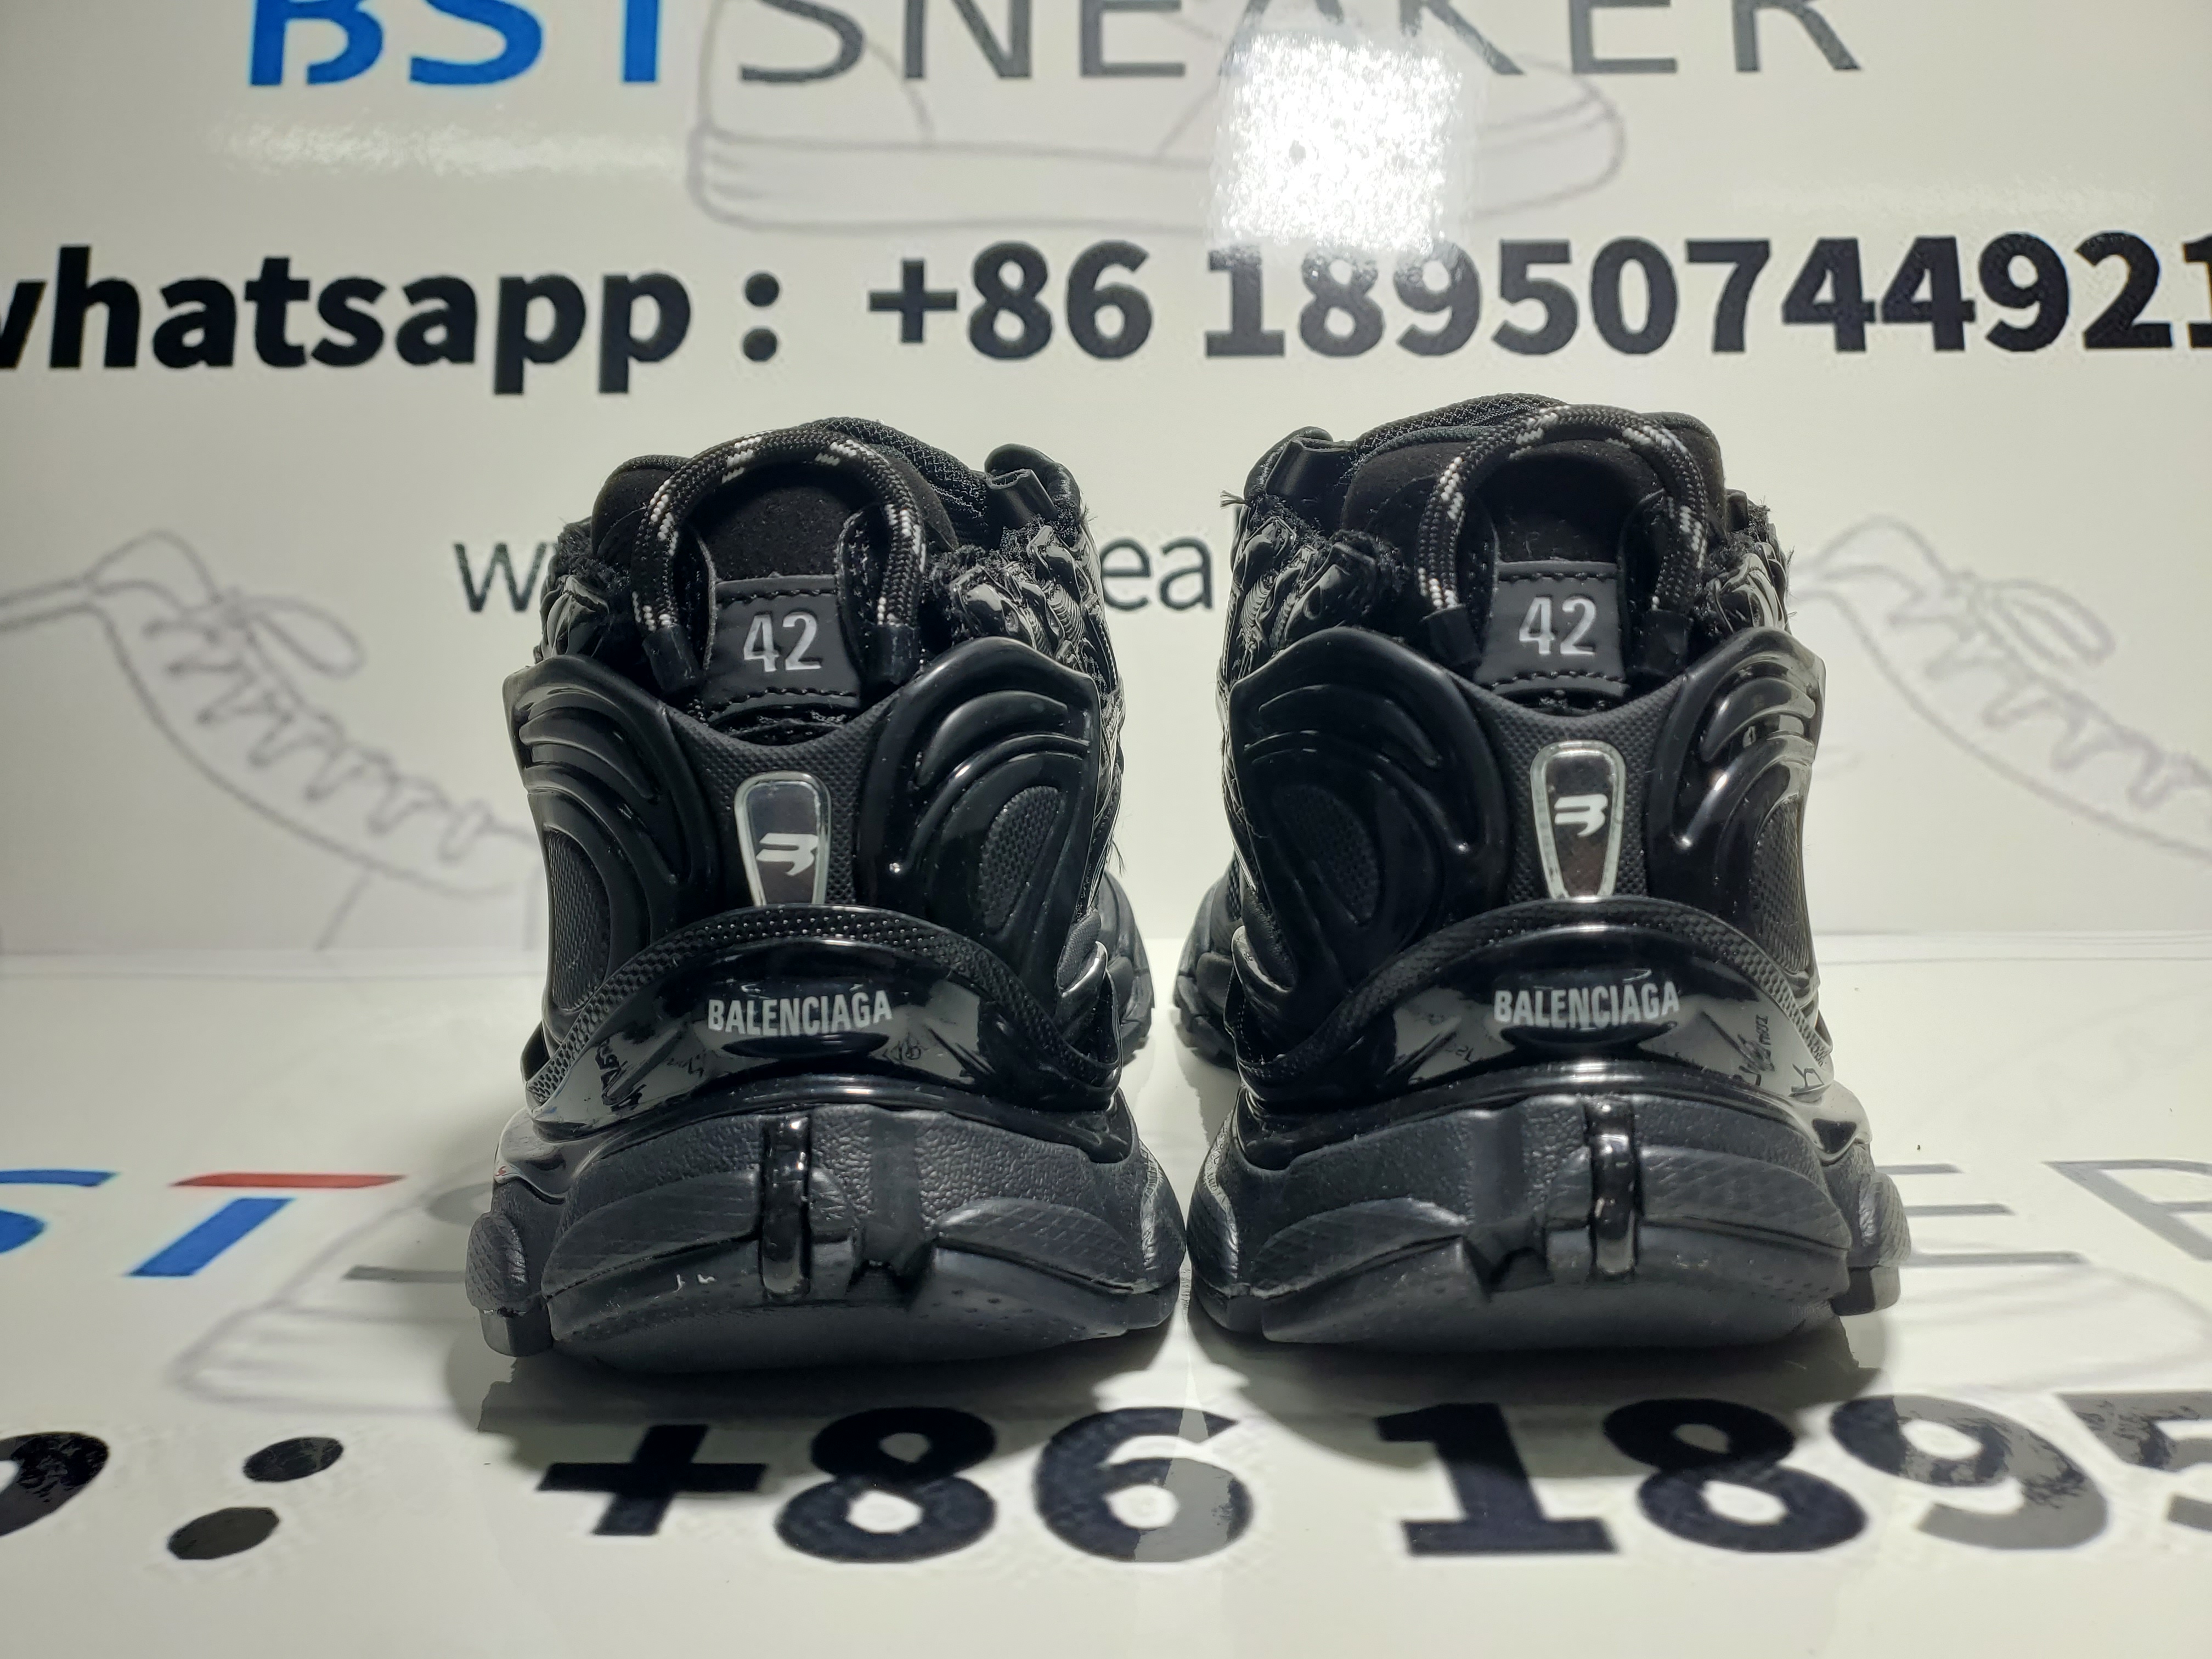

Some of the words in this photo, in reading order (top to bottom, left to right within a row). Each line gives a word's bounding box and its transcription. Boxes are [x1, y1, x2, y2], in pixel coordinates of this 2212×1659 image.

[868, 240, 1152, 361] +86
[743, 612, 822, 673] 42
[1519, 596, 1596, 656] 42
[707, 990, 894, 1036] BALENCIAGA
[1493, 980, 1680, 1029] BALENCIAGA
[537, 1404, 1255, 1564] +86
